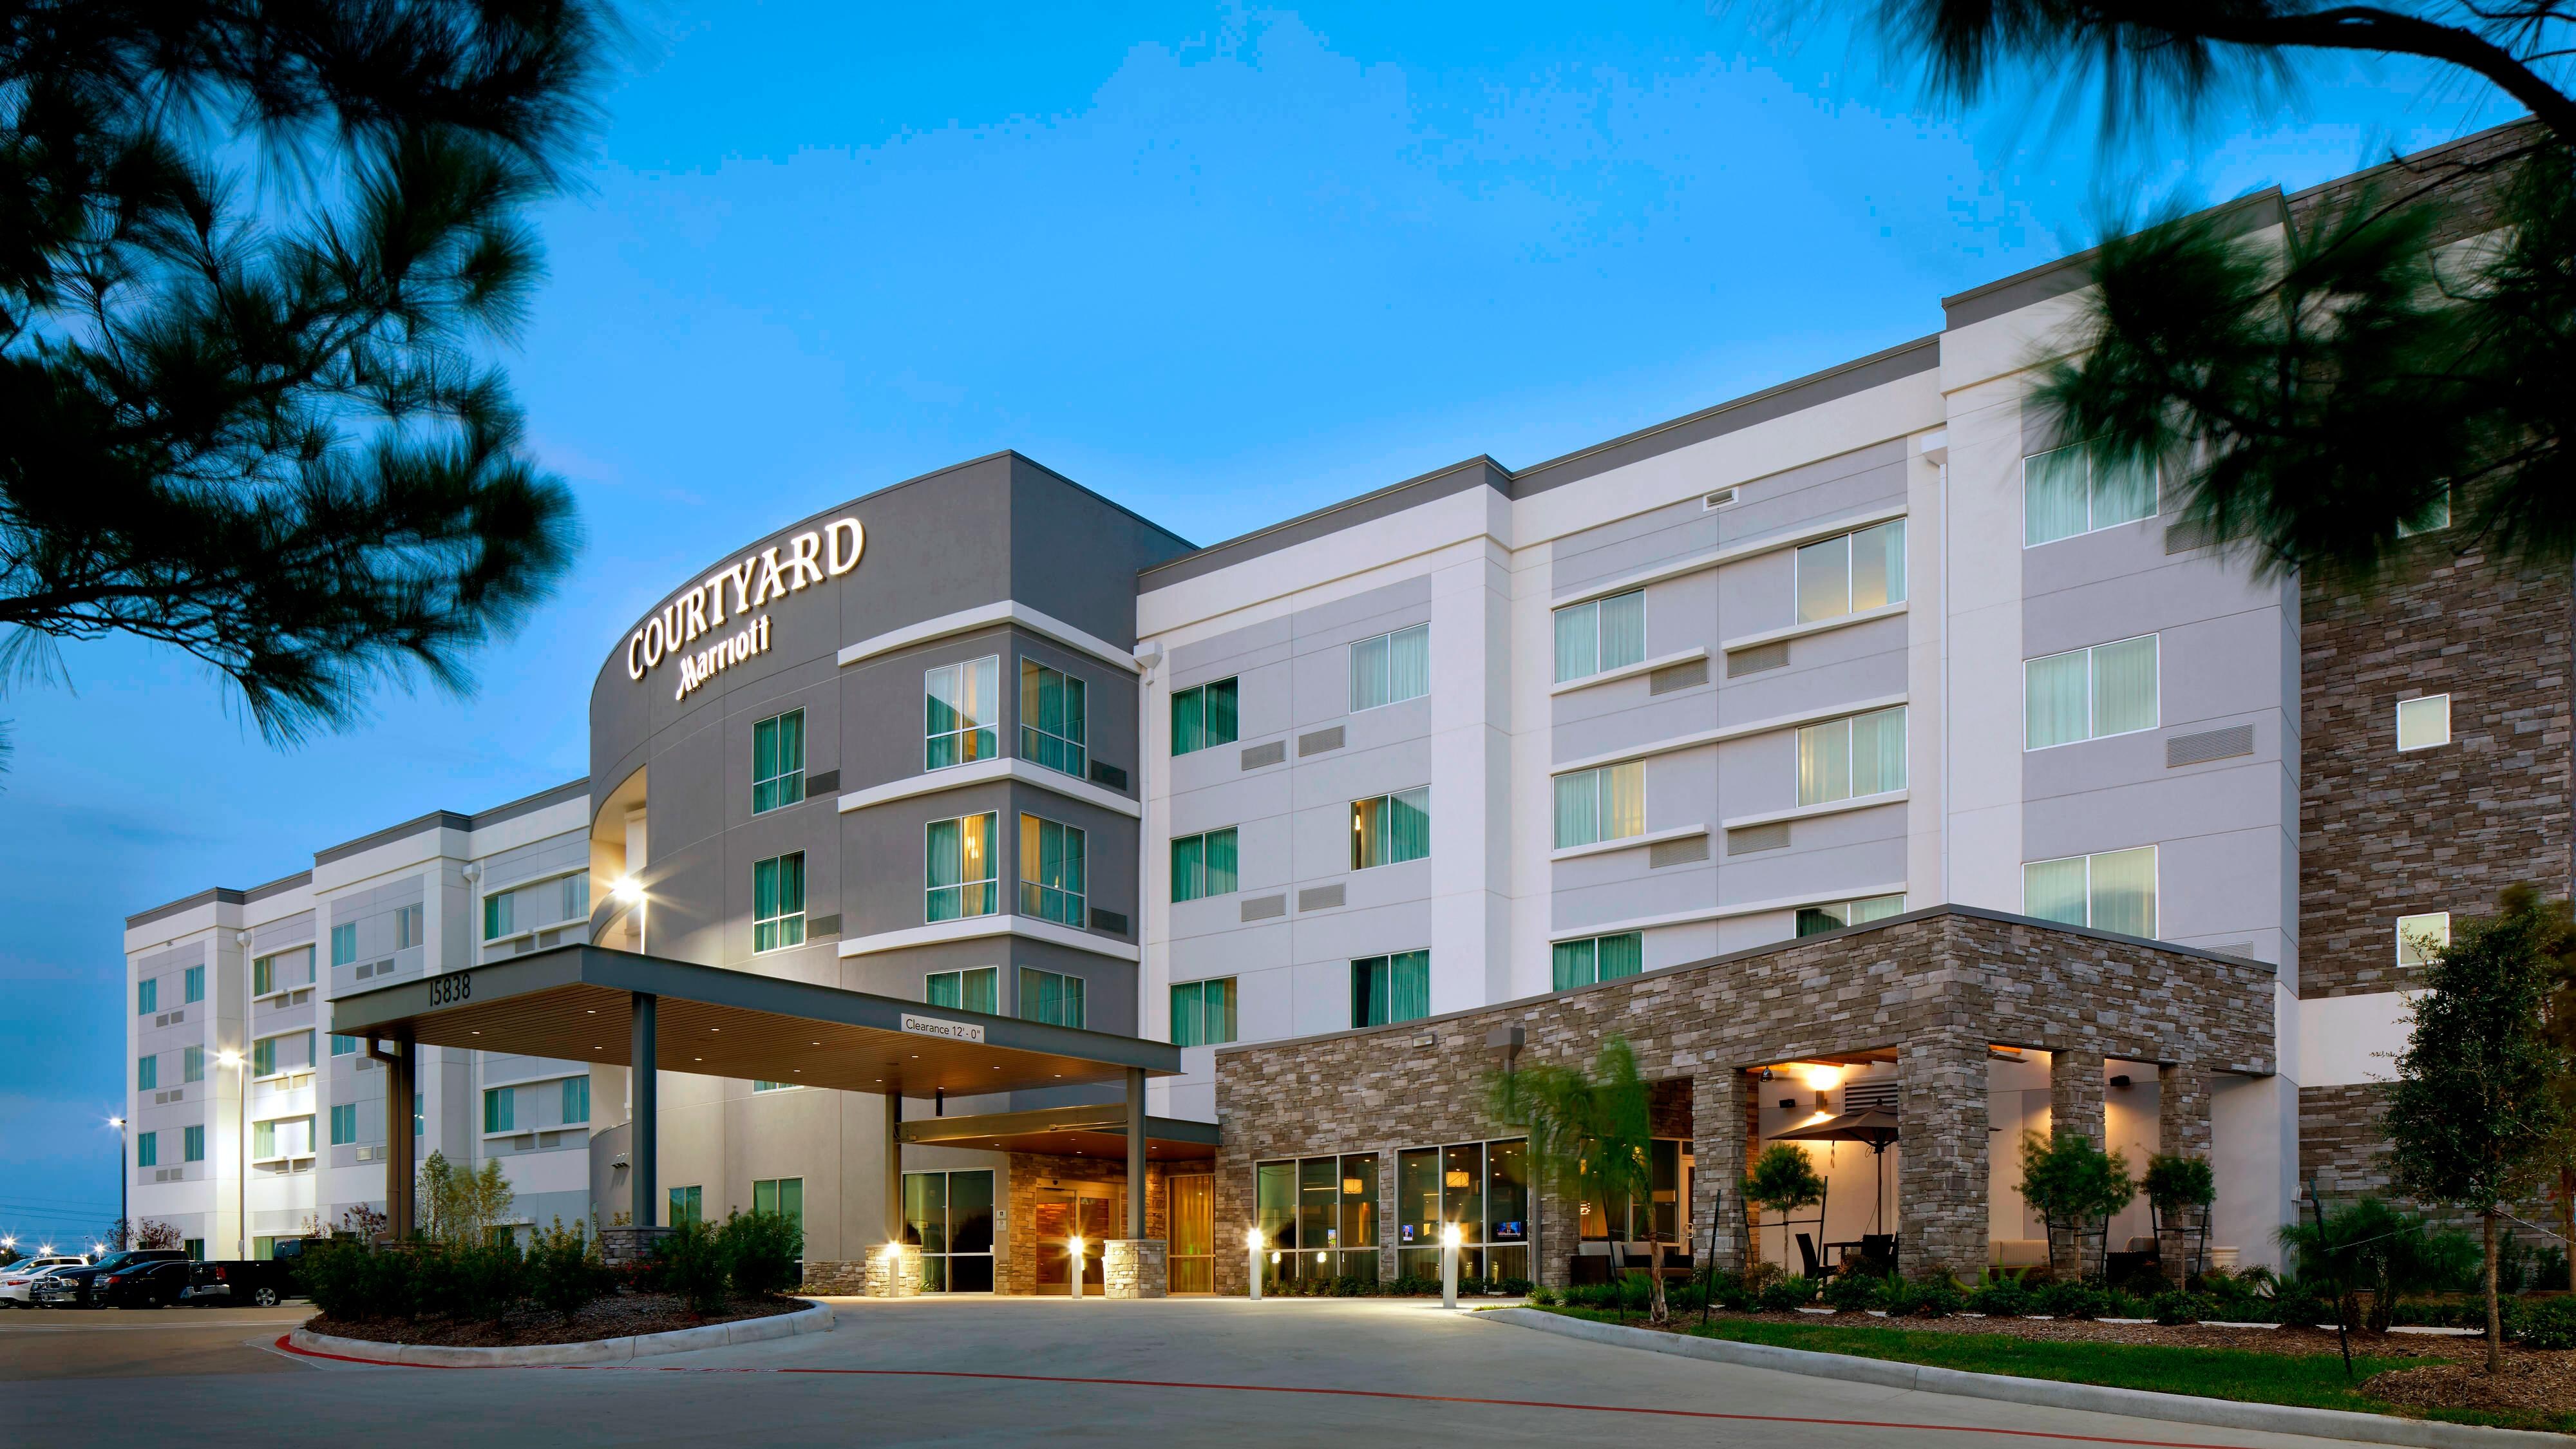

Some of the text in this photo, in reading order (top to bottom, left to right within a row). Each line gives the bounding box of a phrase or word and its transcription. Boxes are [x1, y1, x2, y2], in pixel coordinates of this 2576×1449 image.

[628, 518, 866, 680] COURTYARD
[676, 614, 773, 701] Marriott
[430, 973, 470, 1007] 15838
[906, 1019, 949, 1034] Clearance
